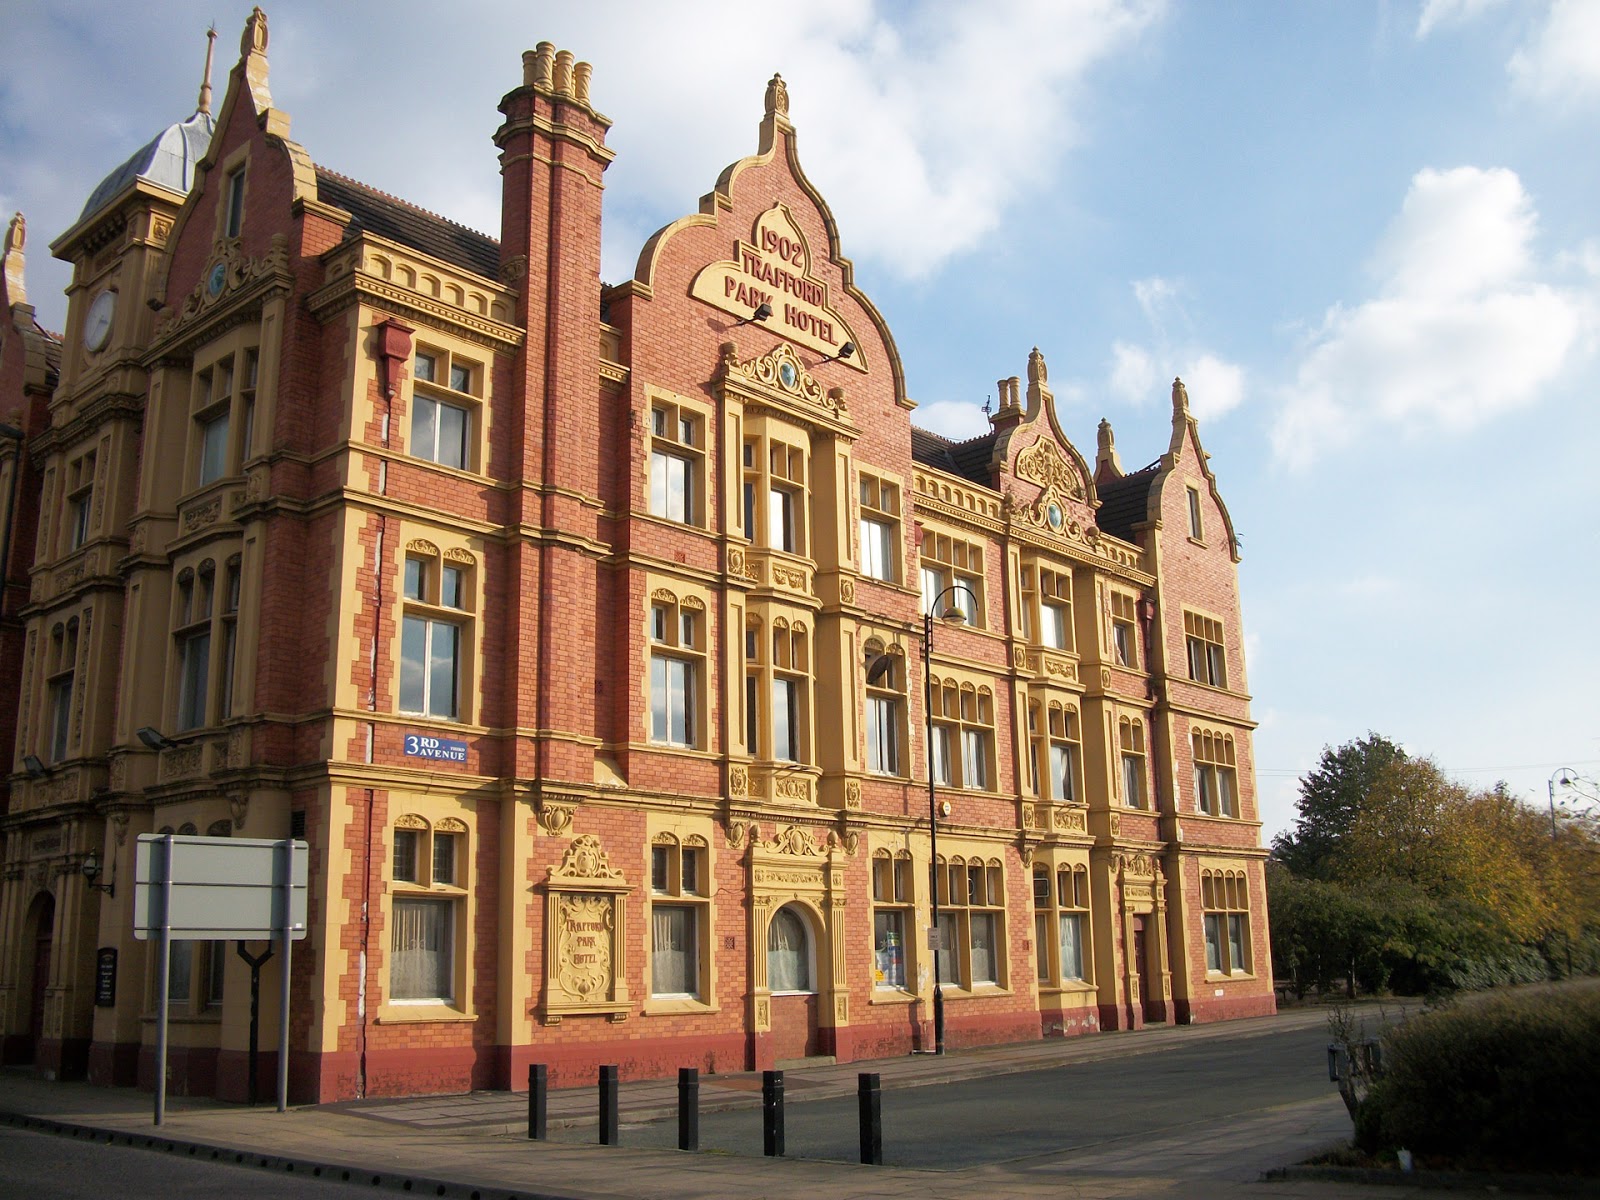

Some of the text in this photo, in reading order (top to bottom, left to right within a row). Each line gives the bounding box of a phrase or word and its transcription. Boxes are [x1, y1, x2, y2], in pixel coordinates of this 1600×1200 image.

[761, 226, 804, 268] 1902
[741, 250, 823, 307] TRAFFORD
[784, 303, 838, 346] HOTEL
[419, 748, 465, 761] AVENUE
[576, 936, 597, 948] PARK
